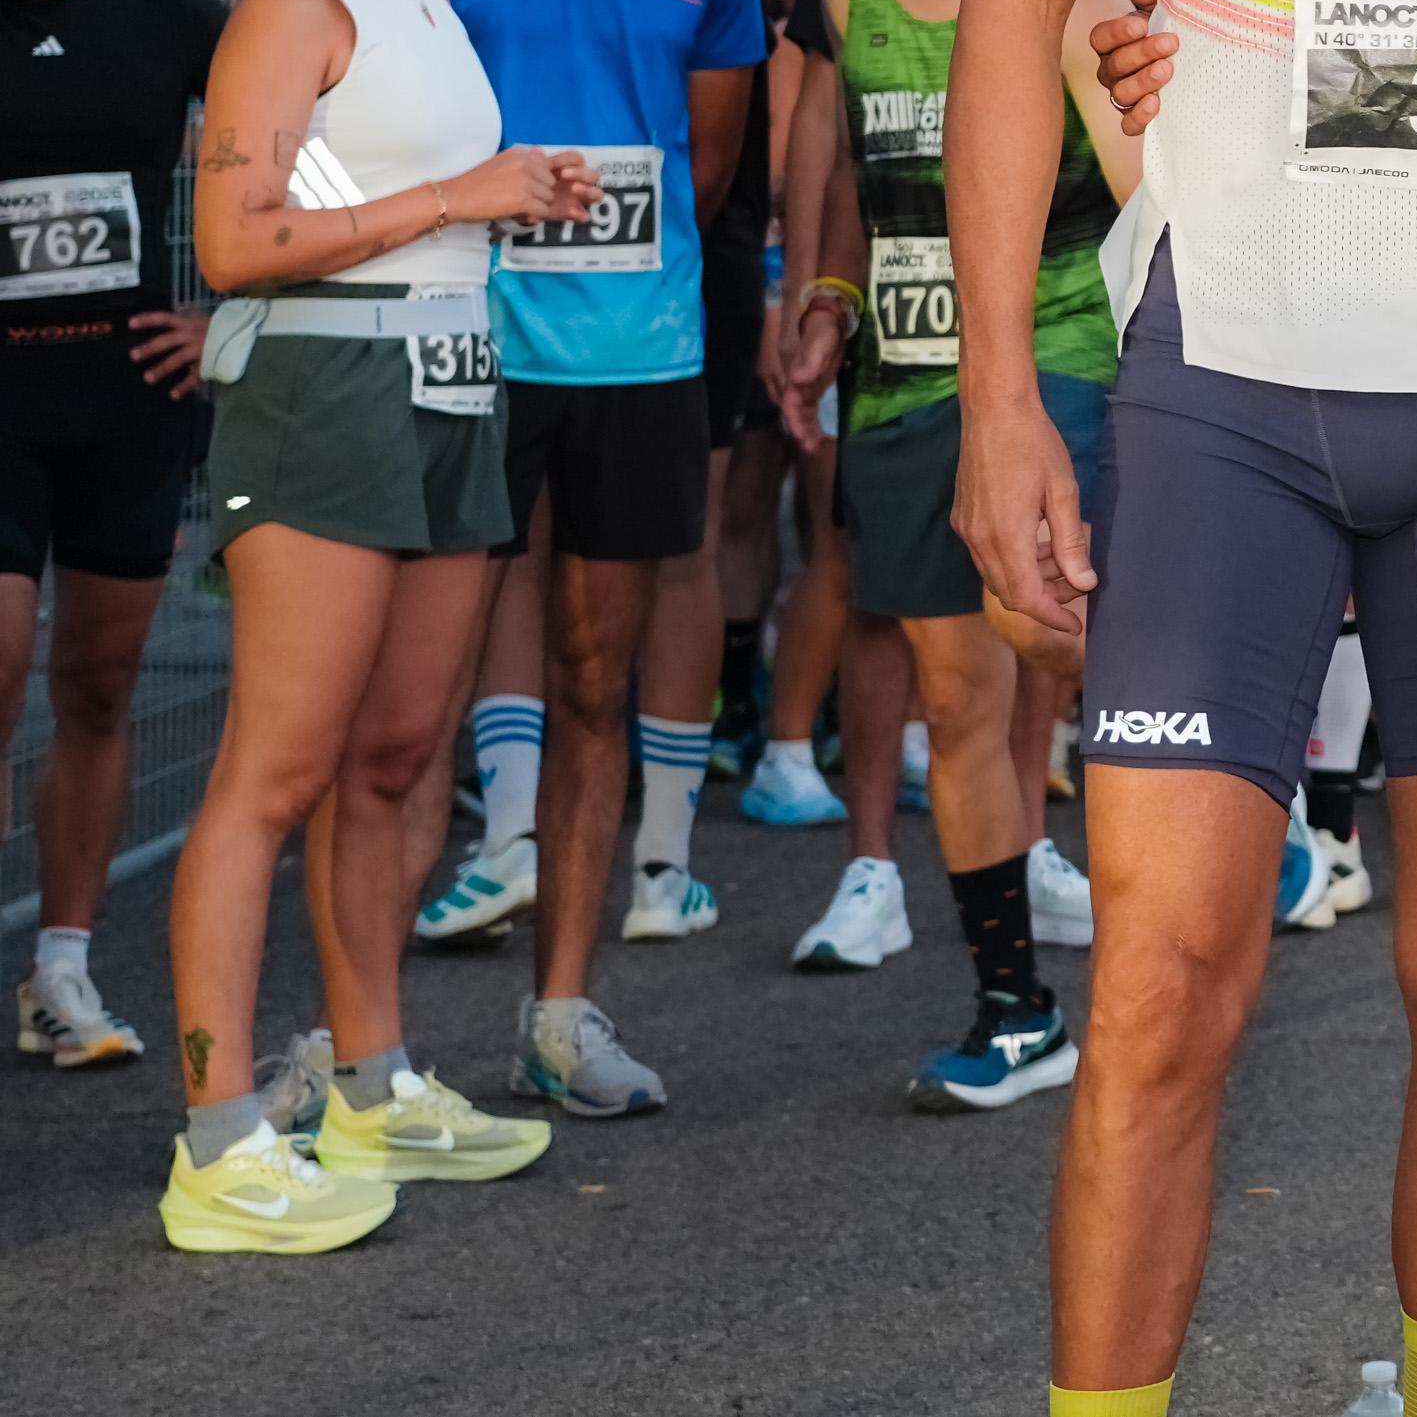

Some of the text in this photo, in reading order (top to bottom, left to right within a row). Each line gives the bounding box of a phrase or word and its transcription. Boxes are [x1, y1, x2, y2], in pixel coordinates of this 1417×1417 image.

[1314, 32, 1328, 45] N
[1333, 32, 1364, 46] 40°
[1298, 164, 1350, 174] OMODA
[1358, 168, 1409, 178] JAECOO
[9, 216, 111, 271] 762
